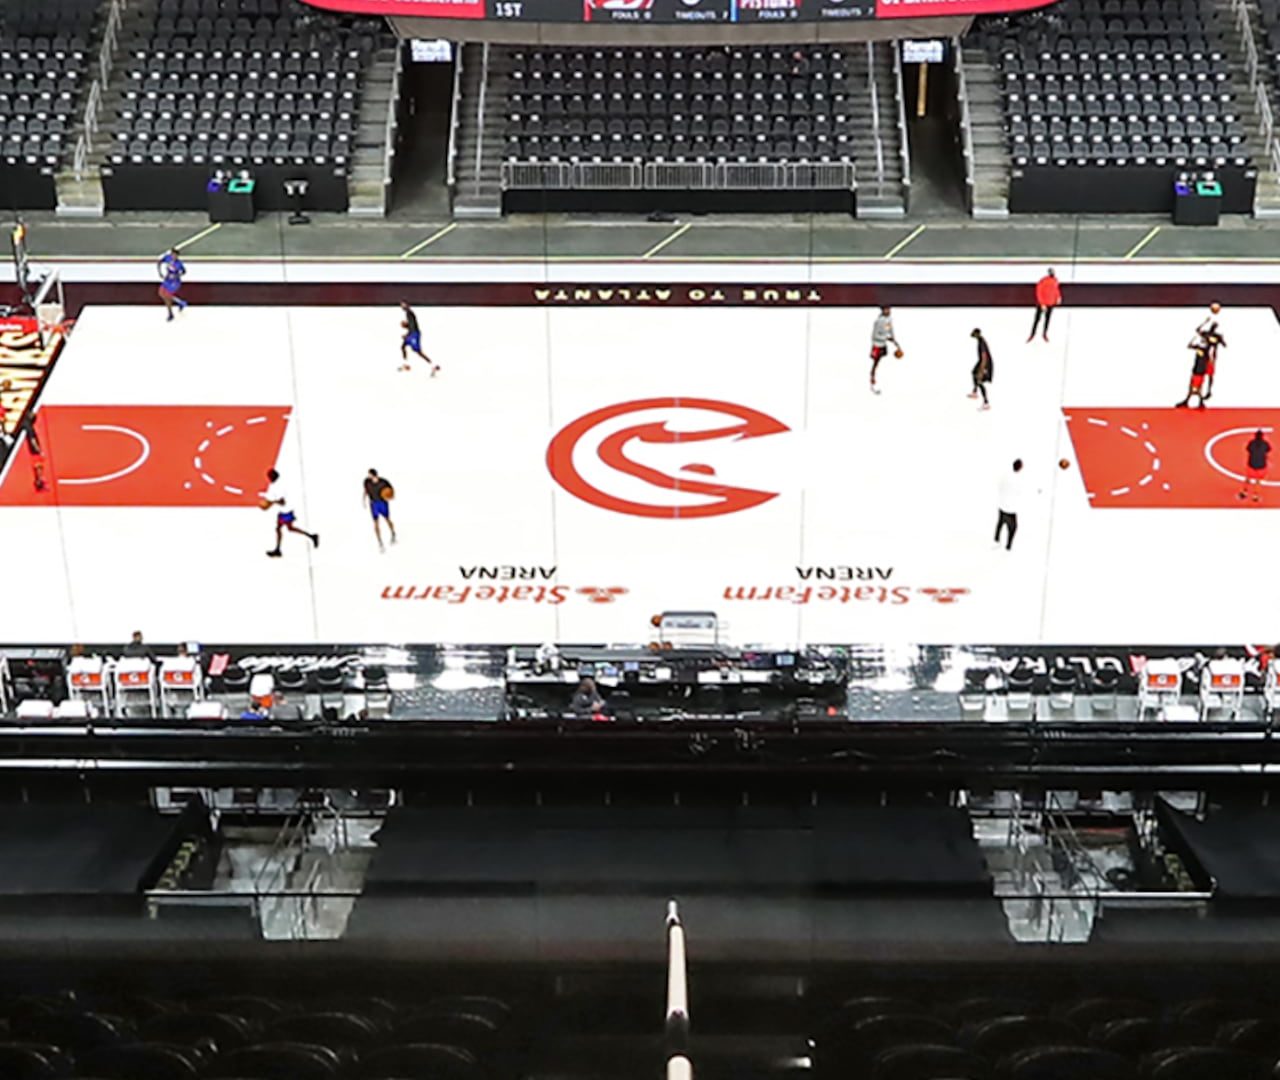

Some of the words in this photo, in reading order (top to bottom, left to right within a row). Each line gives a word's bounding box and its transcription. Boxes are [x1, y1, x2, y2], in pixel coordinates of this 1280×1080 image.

[495, 2, 523, 17] 1ST
[534, 289, 671, 301] ATLANTA
[688, 289, 725, 301] TO
[742, 289, 821, 301] TRUE
[459, 565, 557, 580] ARENA
[796, 565, 894, 580] ARENA
